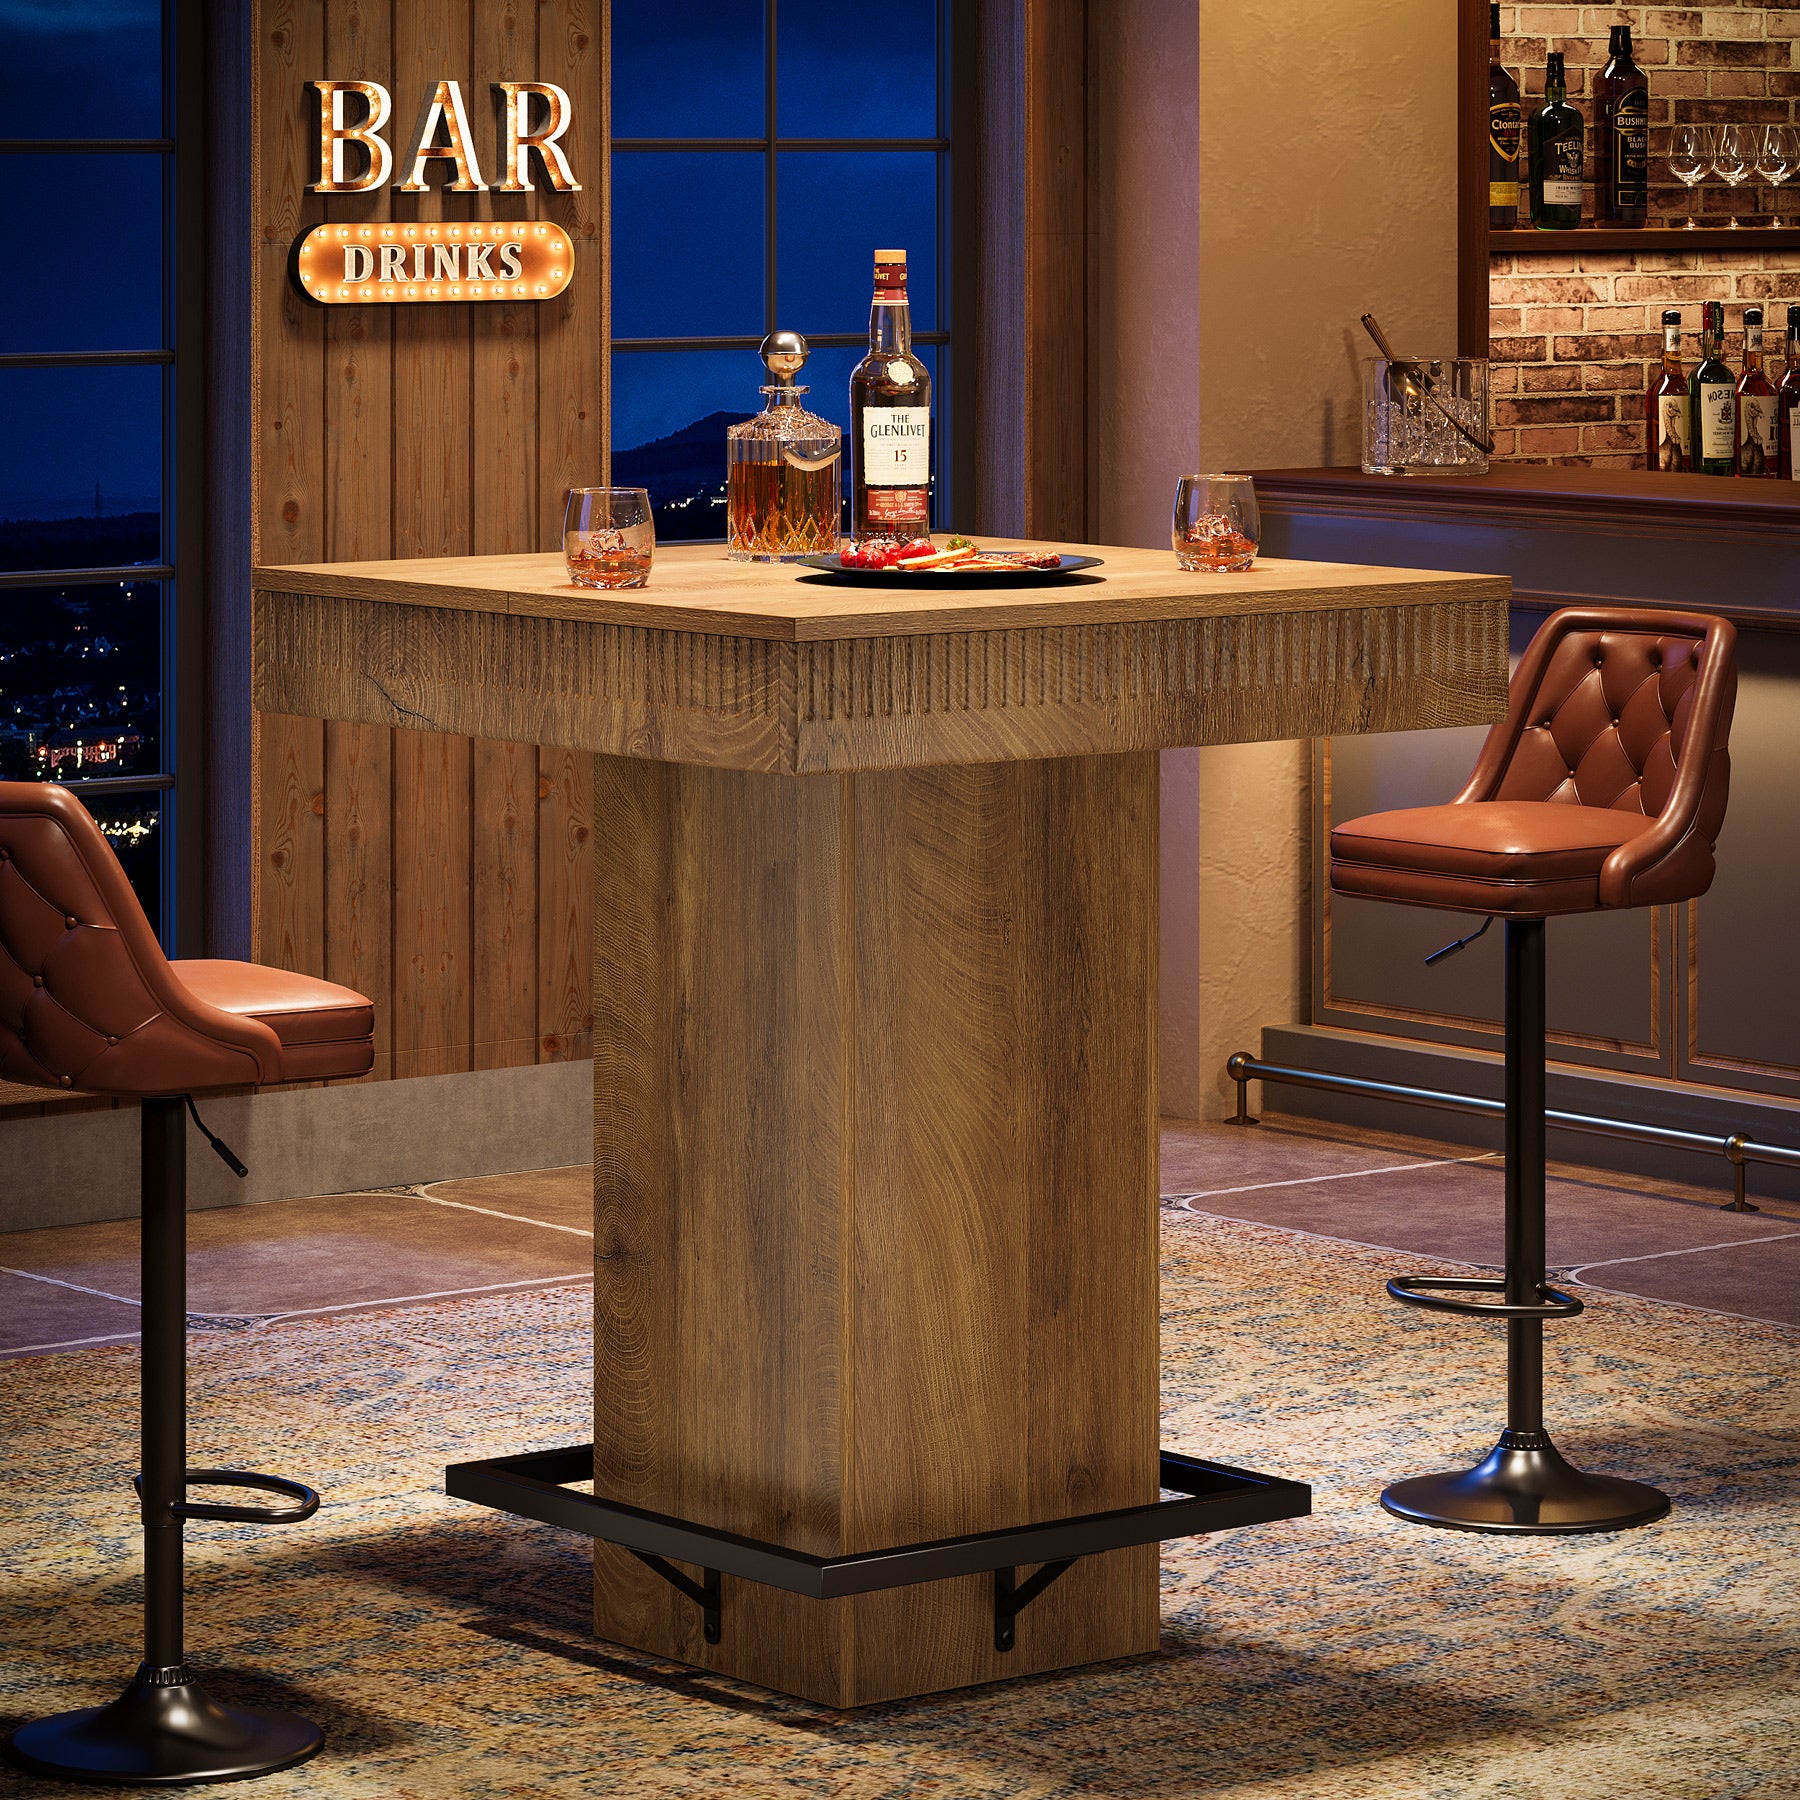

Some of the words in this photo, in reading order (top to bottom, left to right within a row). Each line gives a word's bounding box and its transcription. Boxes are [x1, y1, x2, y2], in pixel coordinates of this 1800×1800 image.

[304, 80, 582, 192] BAR
[342, 242, 523, 283] DRINKS
[890, 414, 910, 424] THE
[870, 424, 926, 438] GLENLIVET
[893, 449, 907, 462] 15
